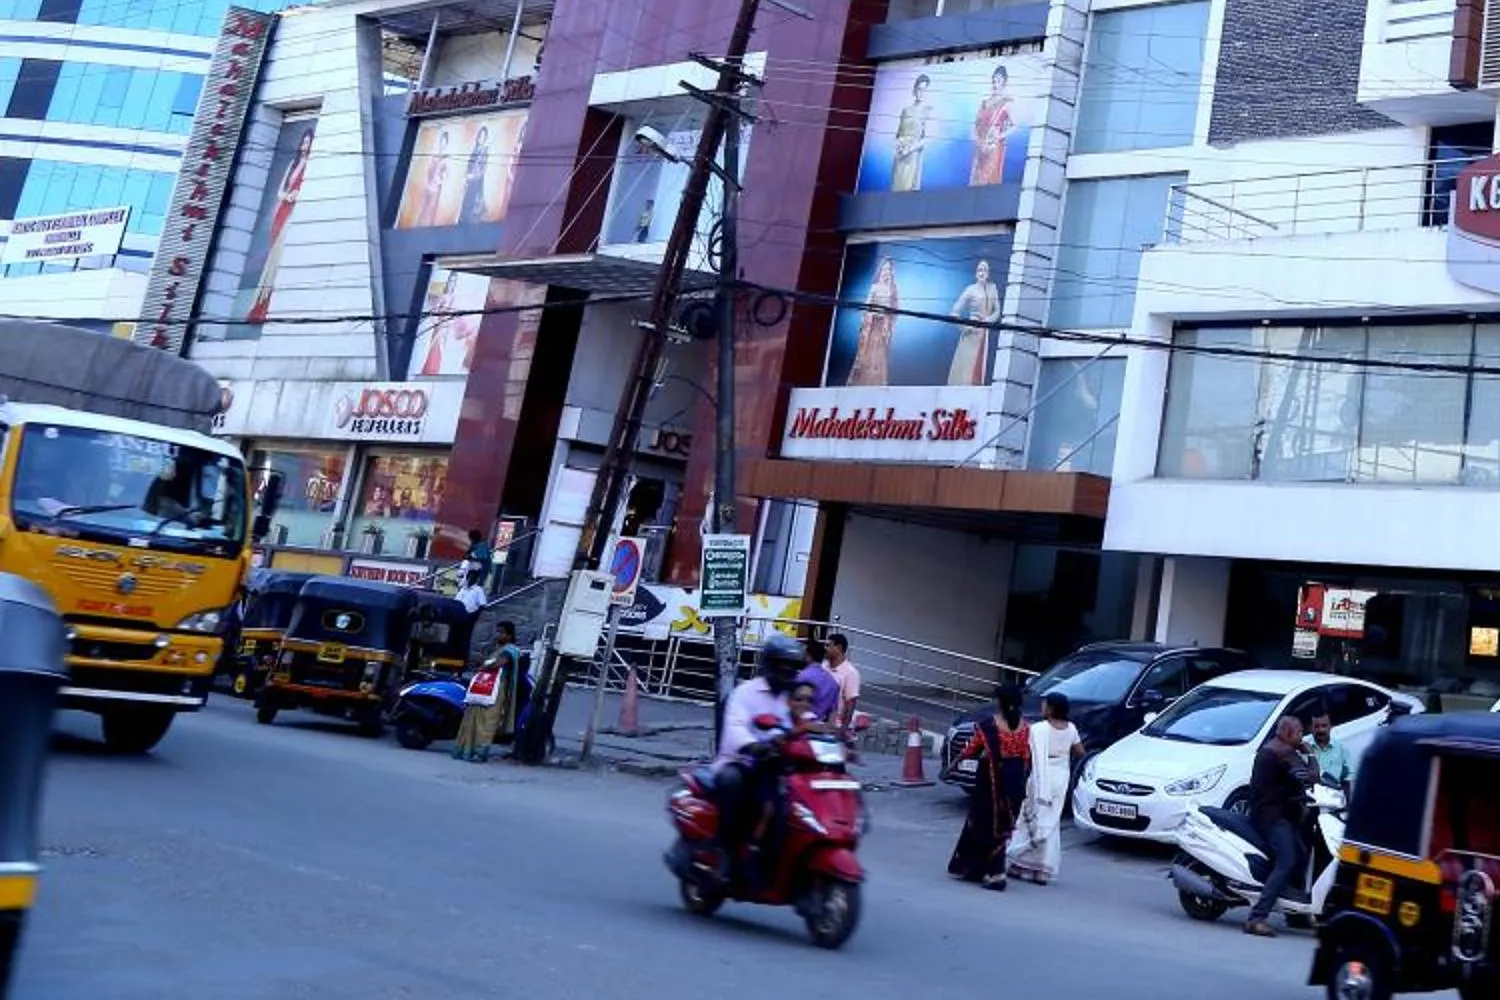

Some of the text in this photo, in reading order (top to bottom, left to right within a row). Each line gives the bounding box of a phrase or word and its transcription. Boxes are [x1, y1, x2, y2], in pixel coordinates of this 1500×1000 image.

[351, 388, 427, 418] JOSCO
[350, 418, 421, 434] JEWELLERS
[926, 407, 977, 441] Silks
